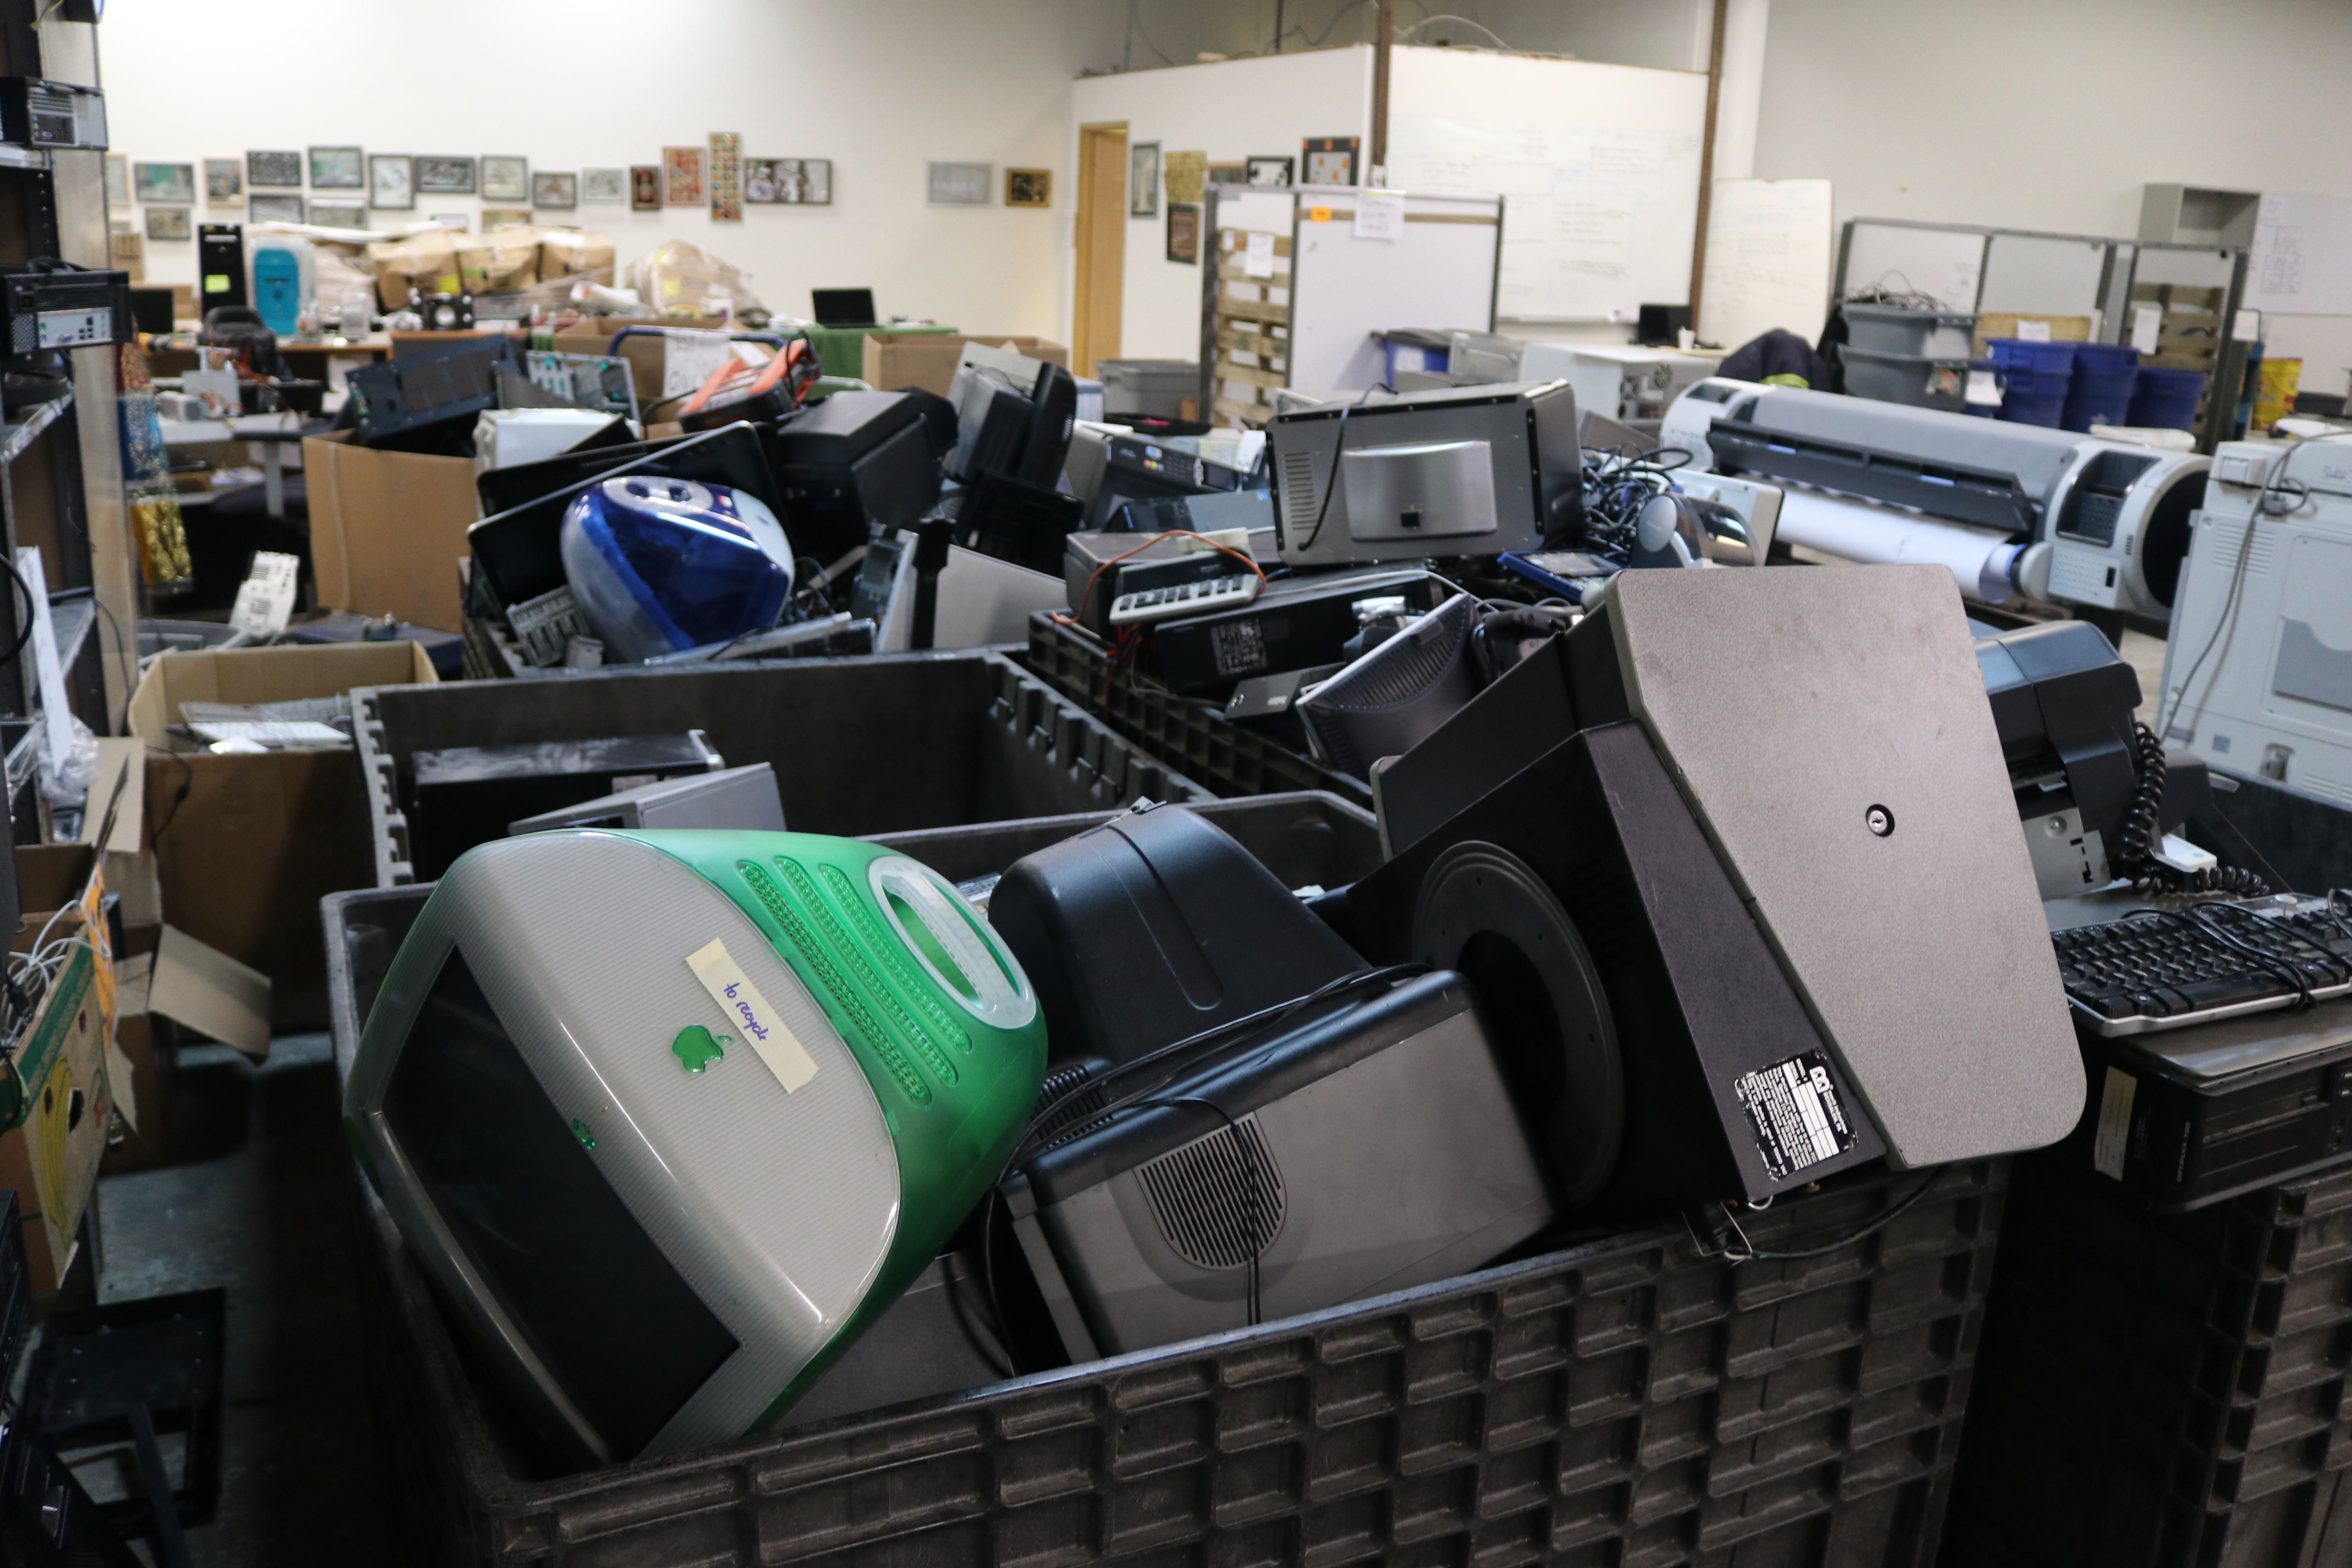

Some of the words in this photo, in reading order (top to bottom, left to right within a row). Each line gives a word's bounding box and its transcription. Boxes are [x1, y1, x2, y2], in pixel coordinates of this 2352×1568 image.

[724, 982, 740, 999] to
[736, 1001, 768, 1041] recycle
[1789, 1061, 1799, 1080] SERIAL
[1796, 1058, 1806, 1078] MODEL
[1833, 1105, 1847, 1134] industries
[1836, 1123, 1843, 1132] PA
[2177, 1142, 2187, 1182] OPTIPLEX
